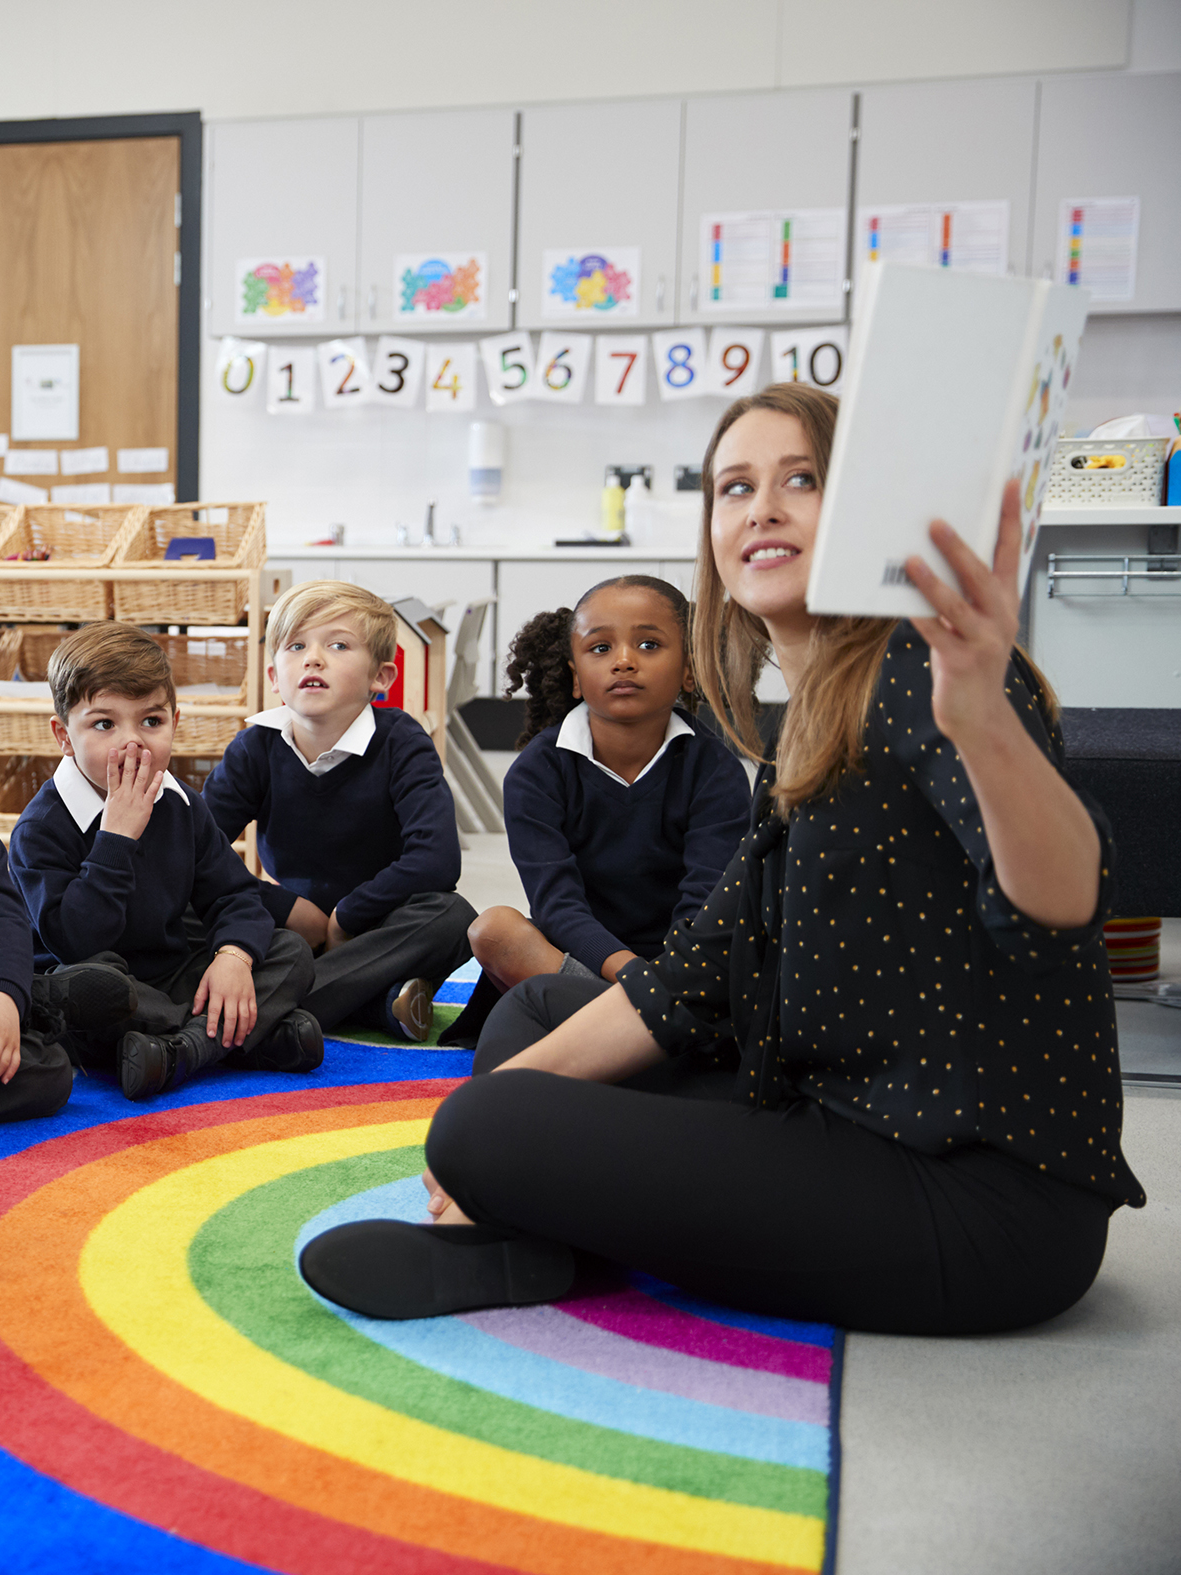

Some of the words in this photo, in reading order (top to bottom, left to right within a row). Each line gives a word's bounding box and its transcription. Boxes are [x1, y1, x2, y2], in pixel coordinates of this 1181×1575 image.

[223, 353, 254, 394] 0
[278, 363, 300, 402] 1
[331, 353, 360, 395] 2
[378, 352, 409, 393] 3
[432, 358, 461, 400] 4
[501, 346, 527, 390] 5
[545, 349, 572, 390] 6
[610, 352, 637, 394] 7
[666, 344, 694, 388] 8
[722, 344, 750, 386] 9
[783, 343, 842, 386] 10
